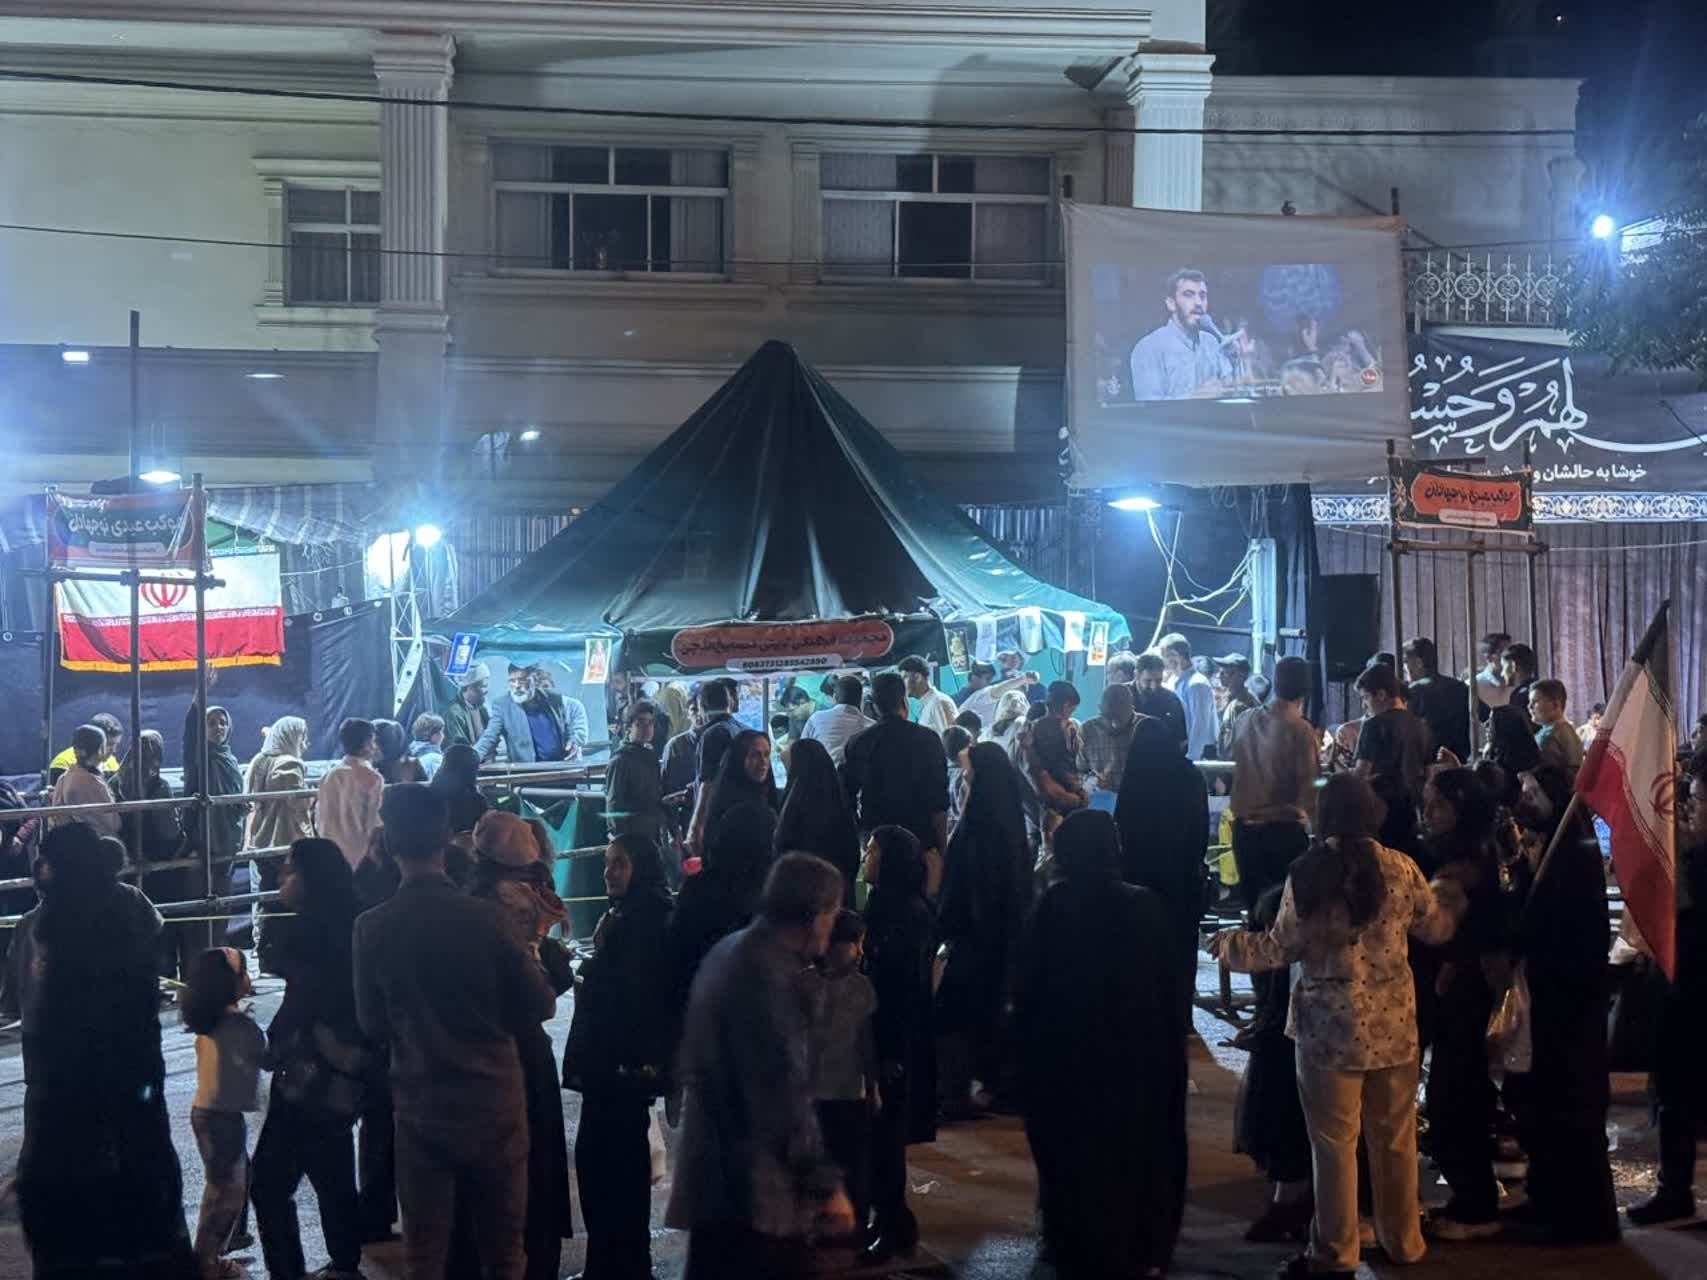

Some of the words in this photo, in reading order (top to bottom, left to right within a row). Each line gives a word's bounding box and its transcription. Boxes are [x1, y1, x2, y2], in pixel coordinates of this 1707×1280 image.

[1542, 463, 1594, 482] حالشان
[1596, 466, 1610, 482] به
[1611, 463, 1648, 482] خوشا
